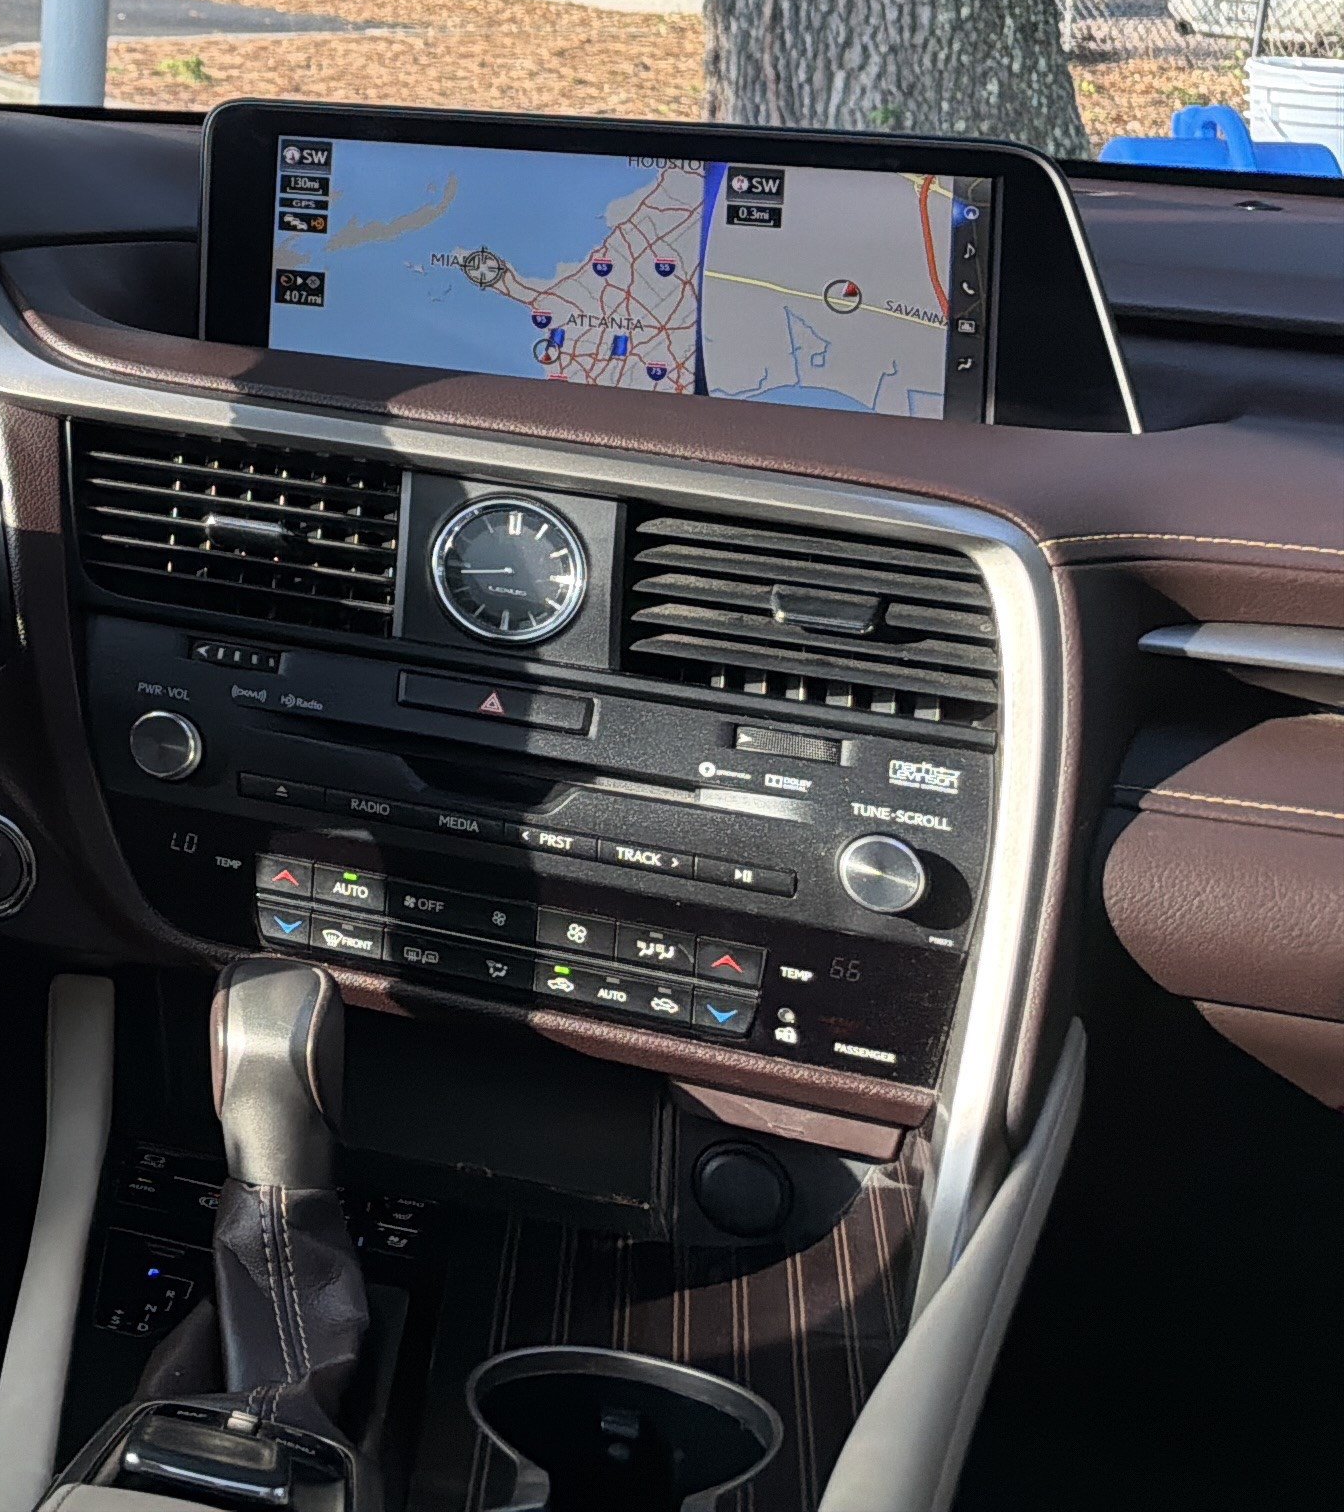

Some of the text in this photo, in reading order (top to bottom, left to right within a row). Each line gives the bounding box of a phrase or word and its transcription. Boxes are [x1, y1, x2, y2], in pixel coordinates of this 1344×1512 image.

[302, 149, 328, 164] SW
[290, 176, 320, 189] 130mi
[752, 179, 780, 194] SW
[292, 200, 316, 208] GPS
[738, 208, 770, 220] 0.3mi
[566, 313, 645, 332] ATLANTA
[296, 698, 324, 710] Radio
[350, 798, 390, 816] RADIO
[438, 814, 480, 834] MEDIA
[539, 832, 574, 850] PRST
[215, 856, 242, 870] TEMP
[616, 846, 662, 866] TRACK
[332, 882, 370, 899] AUTO
[417, 898, 445, 912] OFF
[342, 936, 374, 951] FRONT
[780, 966, 814, 982] TEMP
[597, 988, 627, 1002] AUTO
[834, 1042, 898, 1064] PASSENGER
[166, 1290, 176, 1300] R
